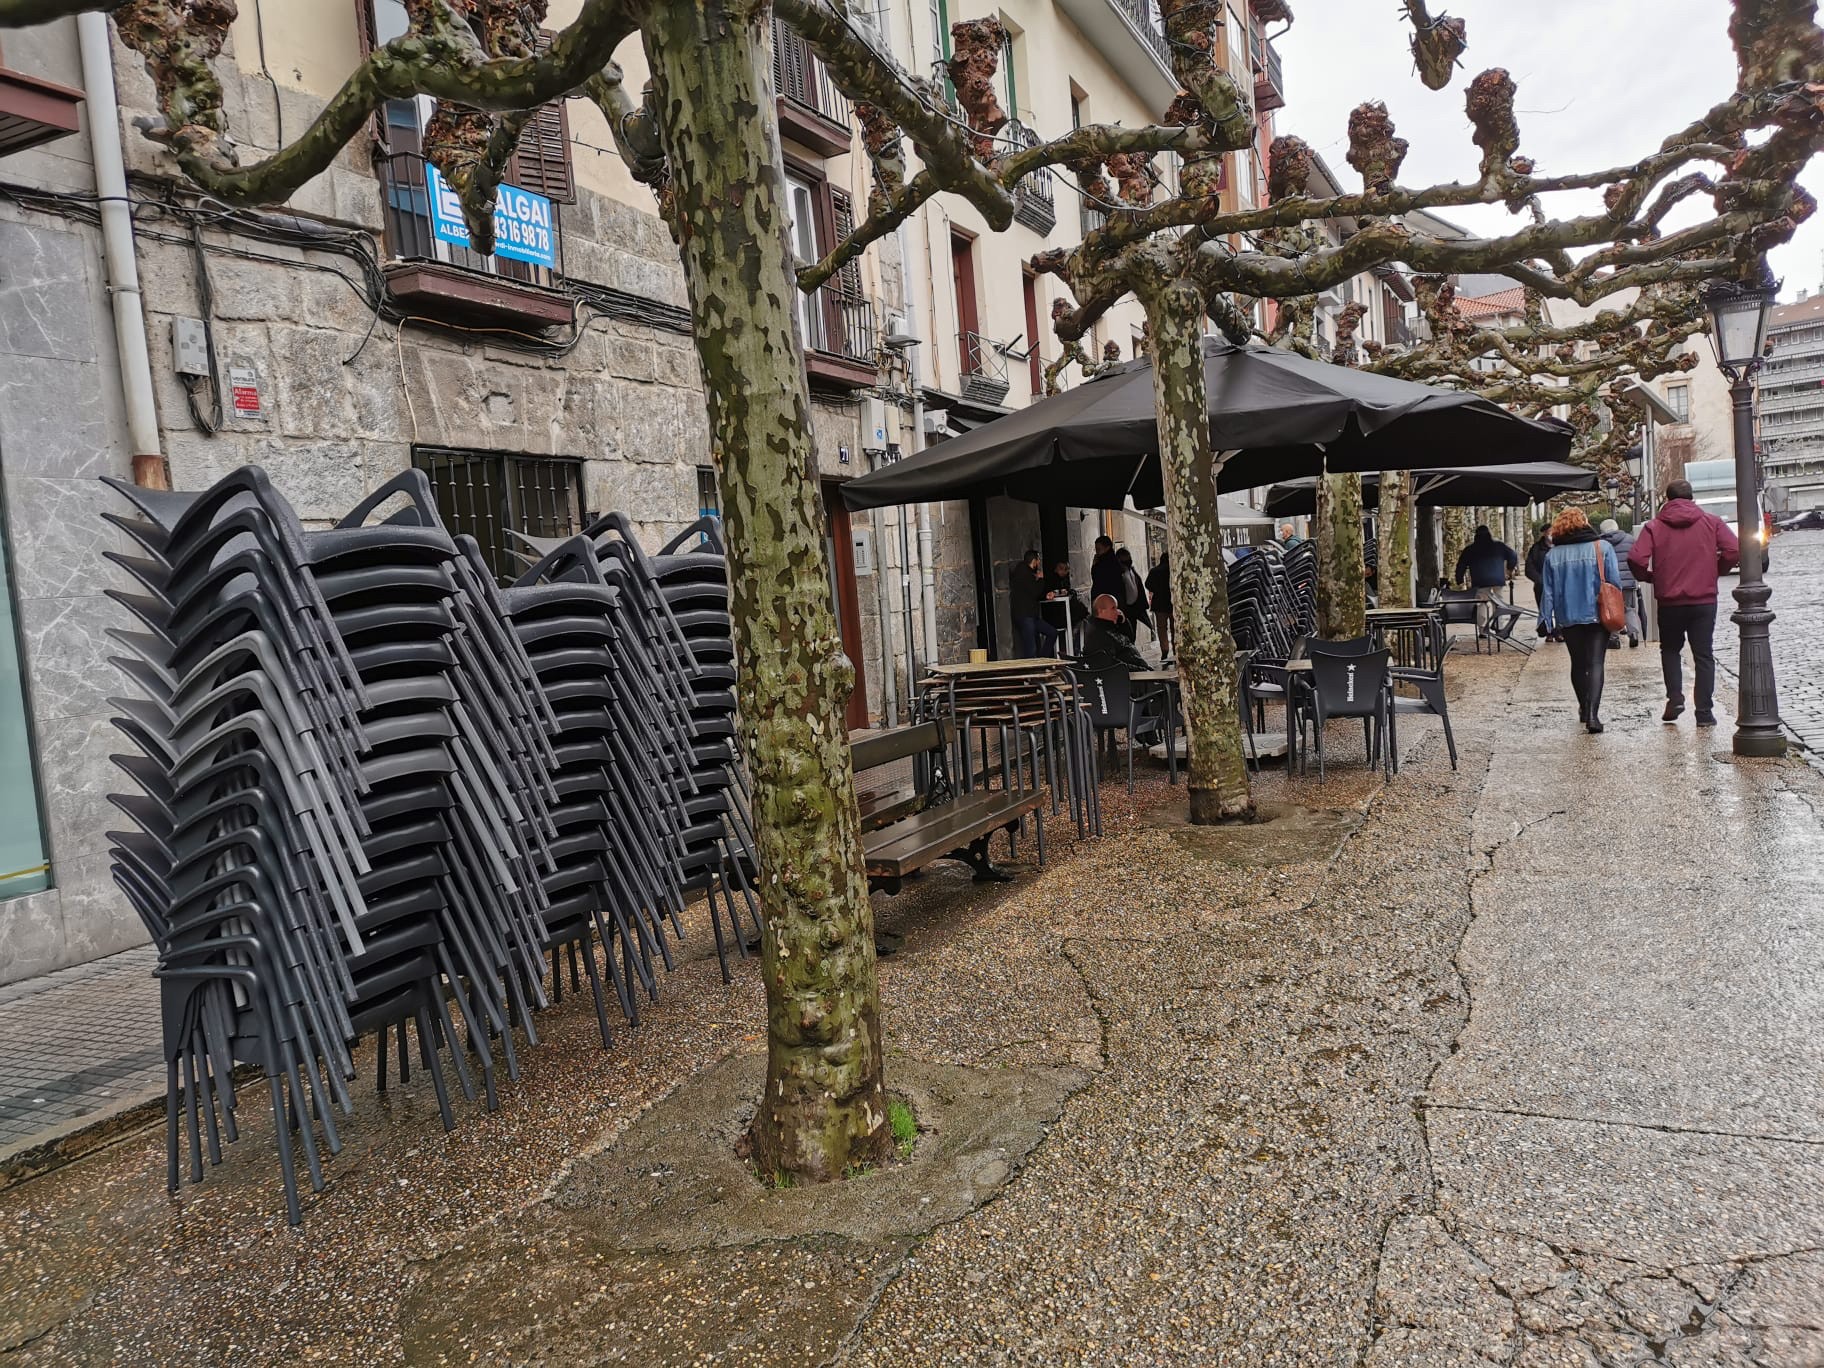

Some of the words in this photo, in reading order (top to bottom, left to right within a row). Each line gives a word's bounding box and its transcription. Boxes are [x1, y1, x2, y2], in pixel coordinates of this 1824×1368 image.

[494, 189, 549, 228] ALGAI
[494, 216, 508, 240] 43
[507, 219, 521, 243] 16
[521, 223, 536, 248] 98
[536, 227, 550, 251] 78
[1346, 672, 1354, 702] Heineken
